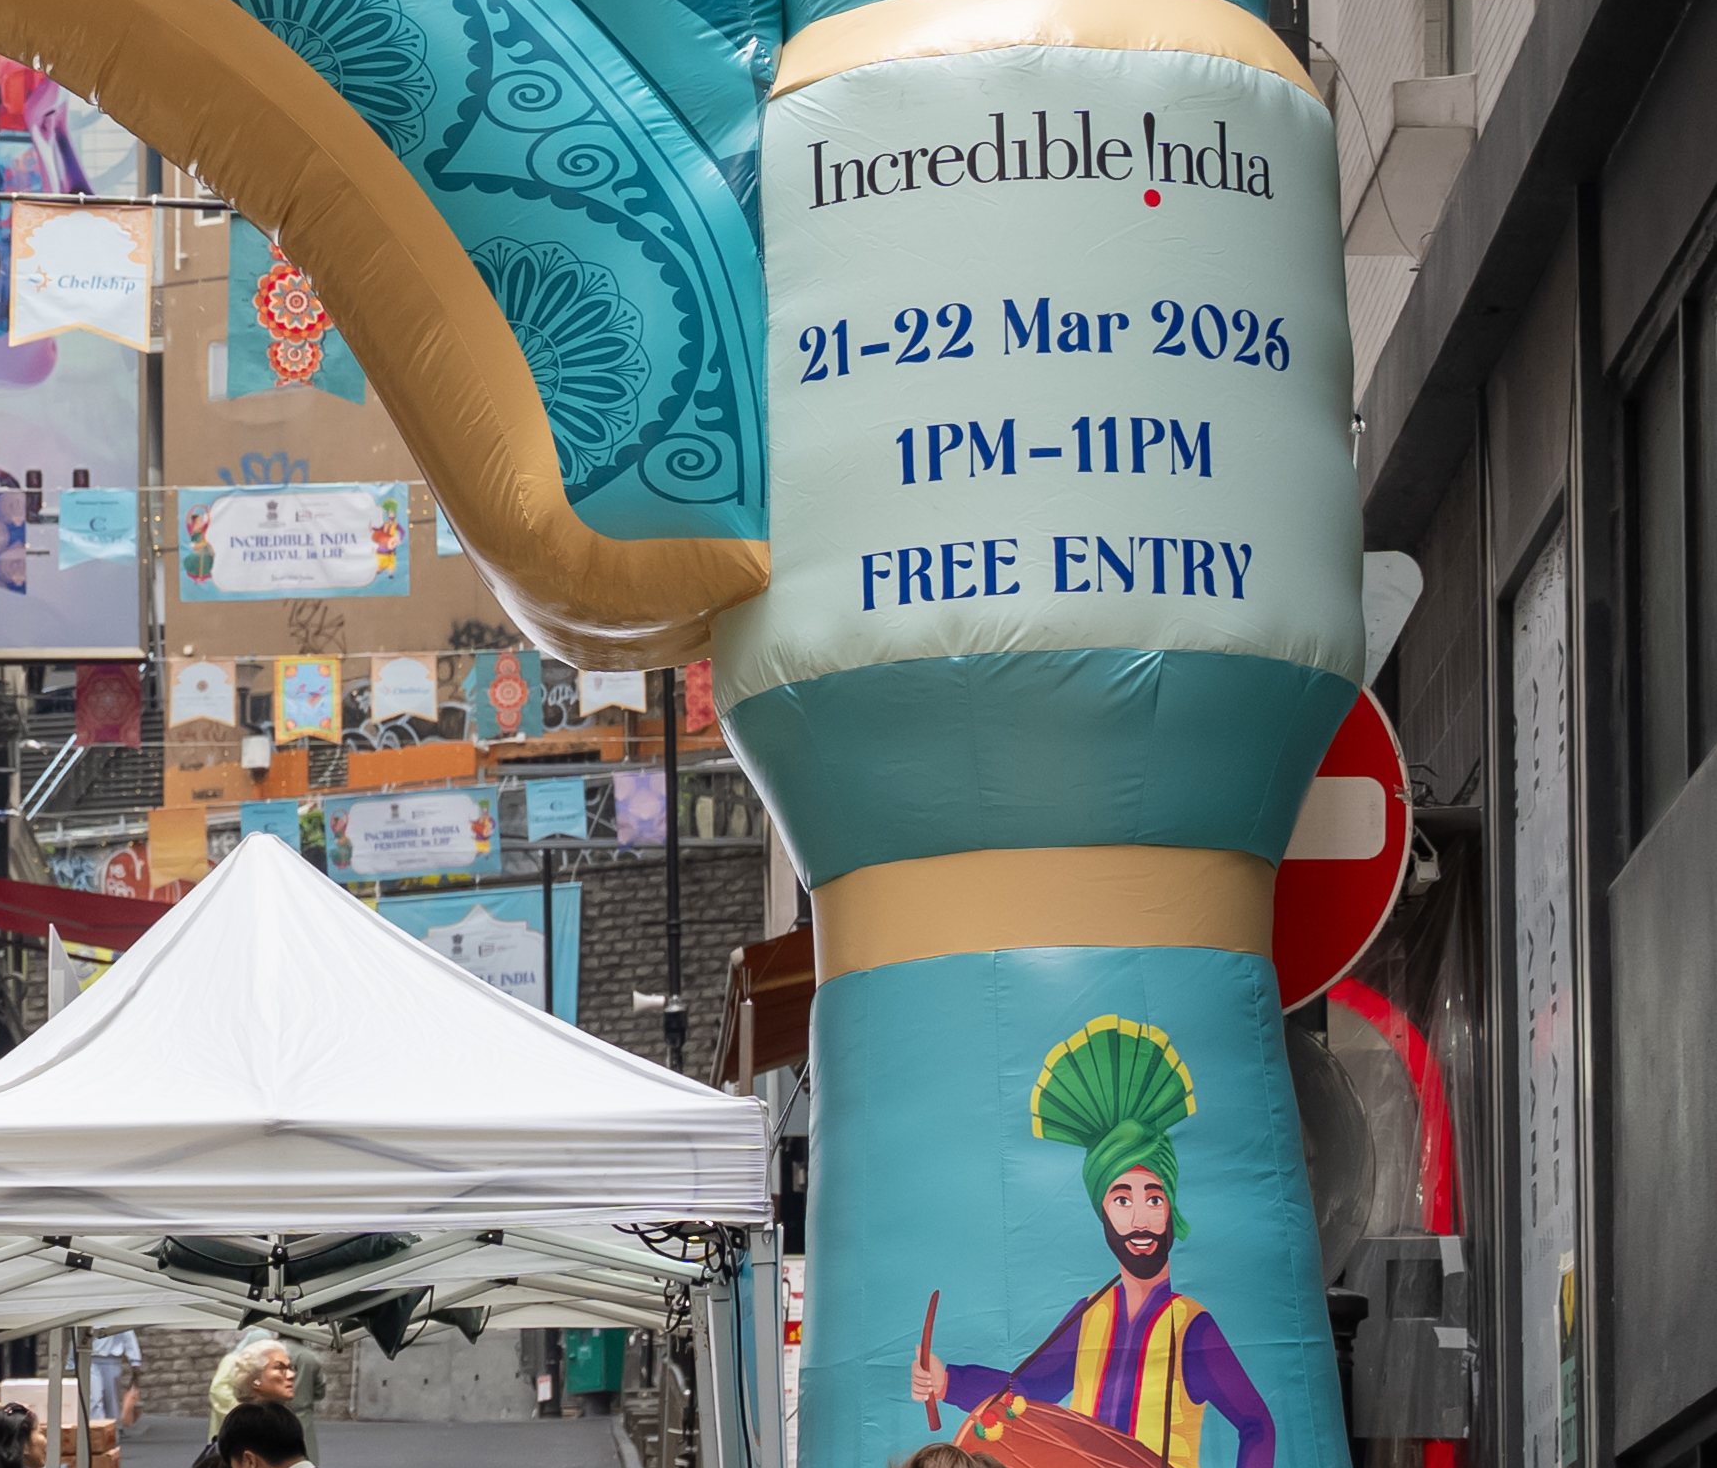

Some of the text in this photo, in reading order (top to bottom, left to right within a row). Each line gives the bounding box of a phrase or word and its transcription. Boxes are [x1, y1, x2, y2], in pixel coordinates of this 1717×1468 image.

[57, 273, 136, 295] Chellship
[798, 297, 1291, 385] 21-22 Mar 2026
[320, 532, 357, 546] INDIA
[861, 536, 1253, 612] FREE ENTRY
